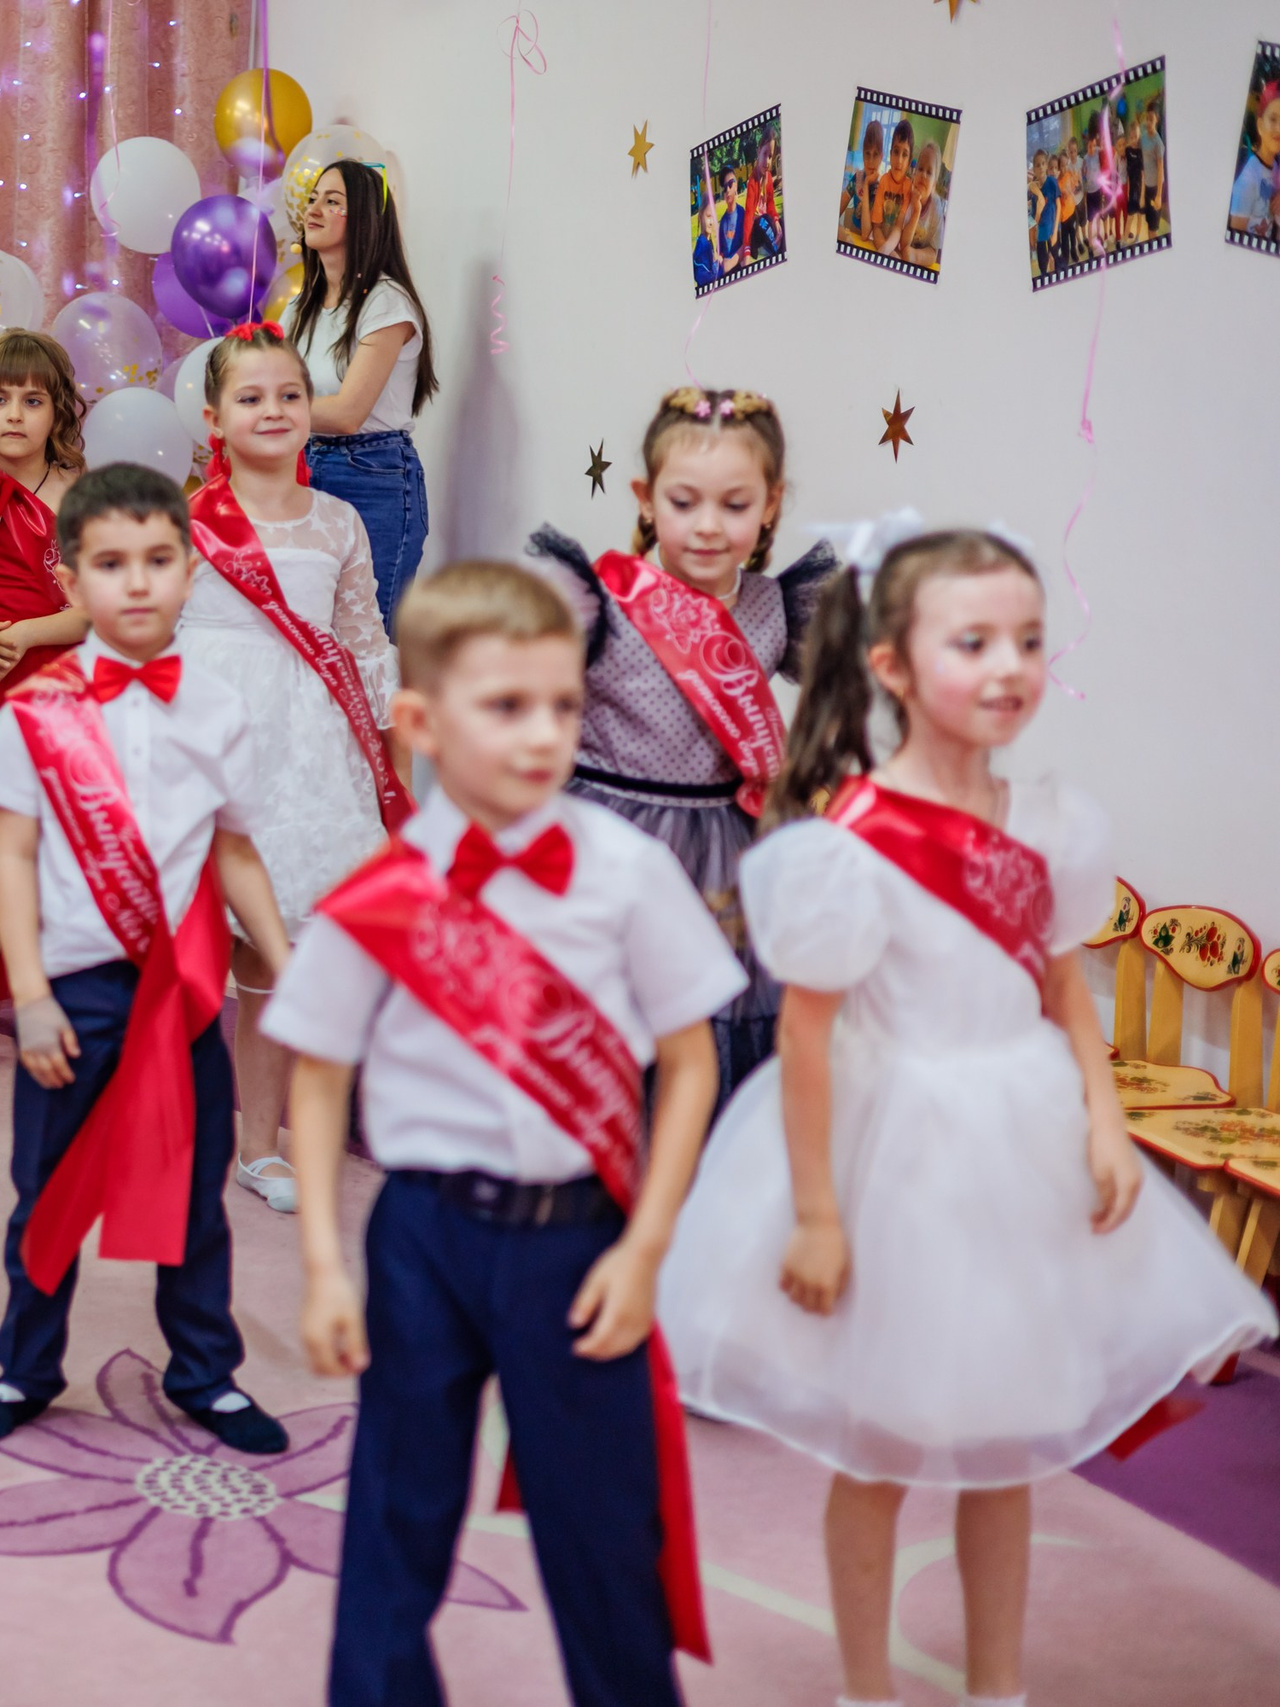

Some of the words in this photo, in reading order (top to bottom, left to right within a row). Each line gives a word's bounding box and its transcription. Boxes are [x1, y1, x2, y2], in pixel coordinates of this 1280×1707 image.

[261, 600, 316, 660] детского
[315, 656, 338, 688] сада
[677, 669, 741, 739] детского
